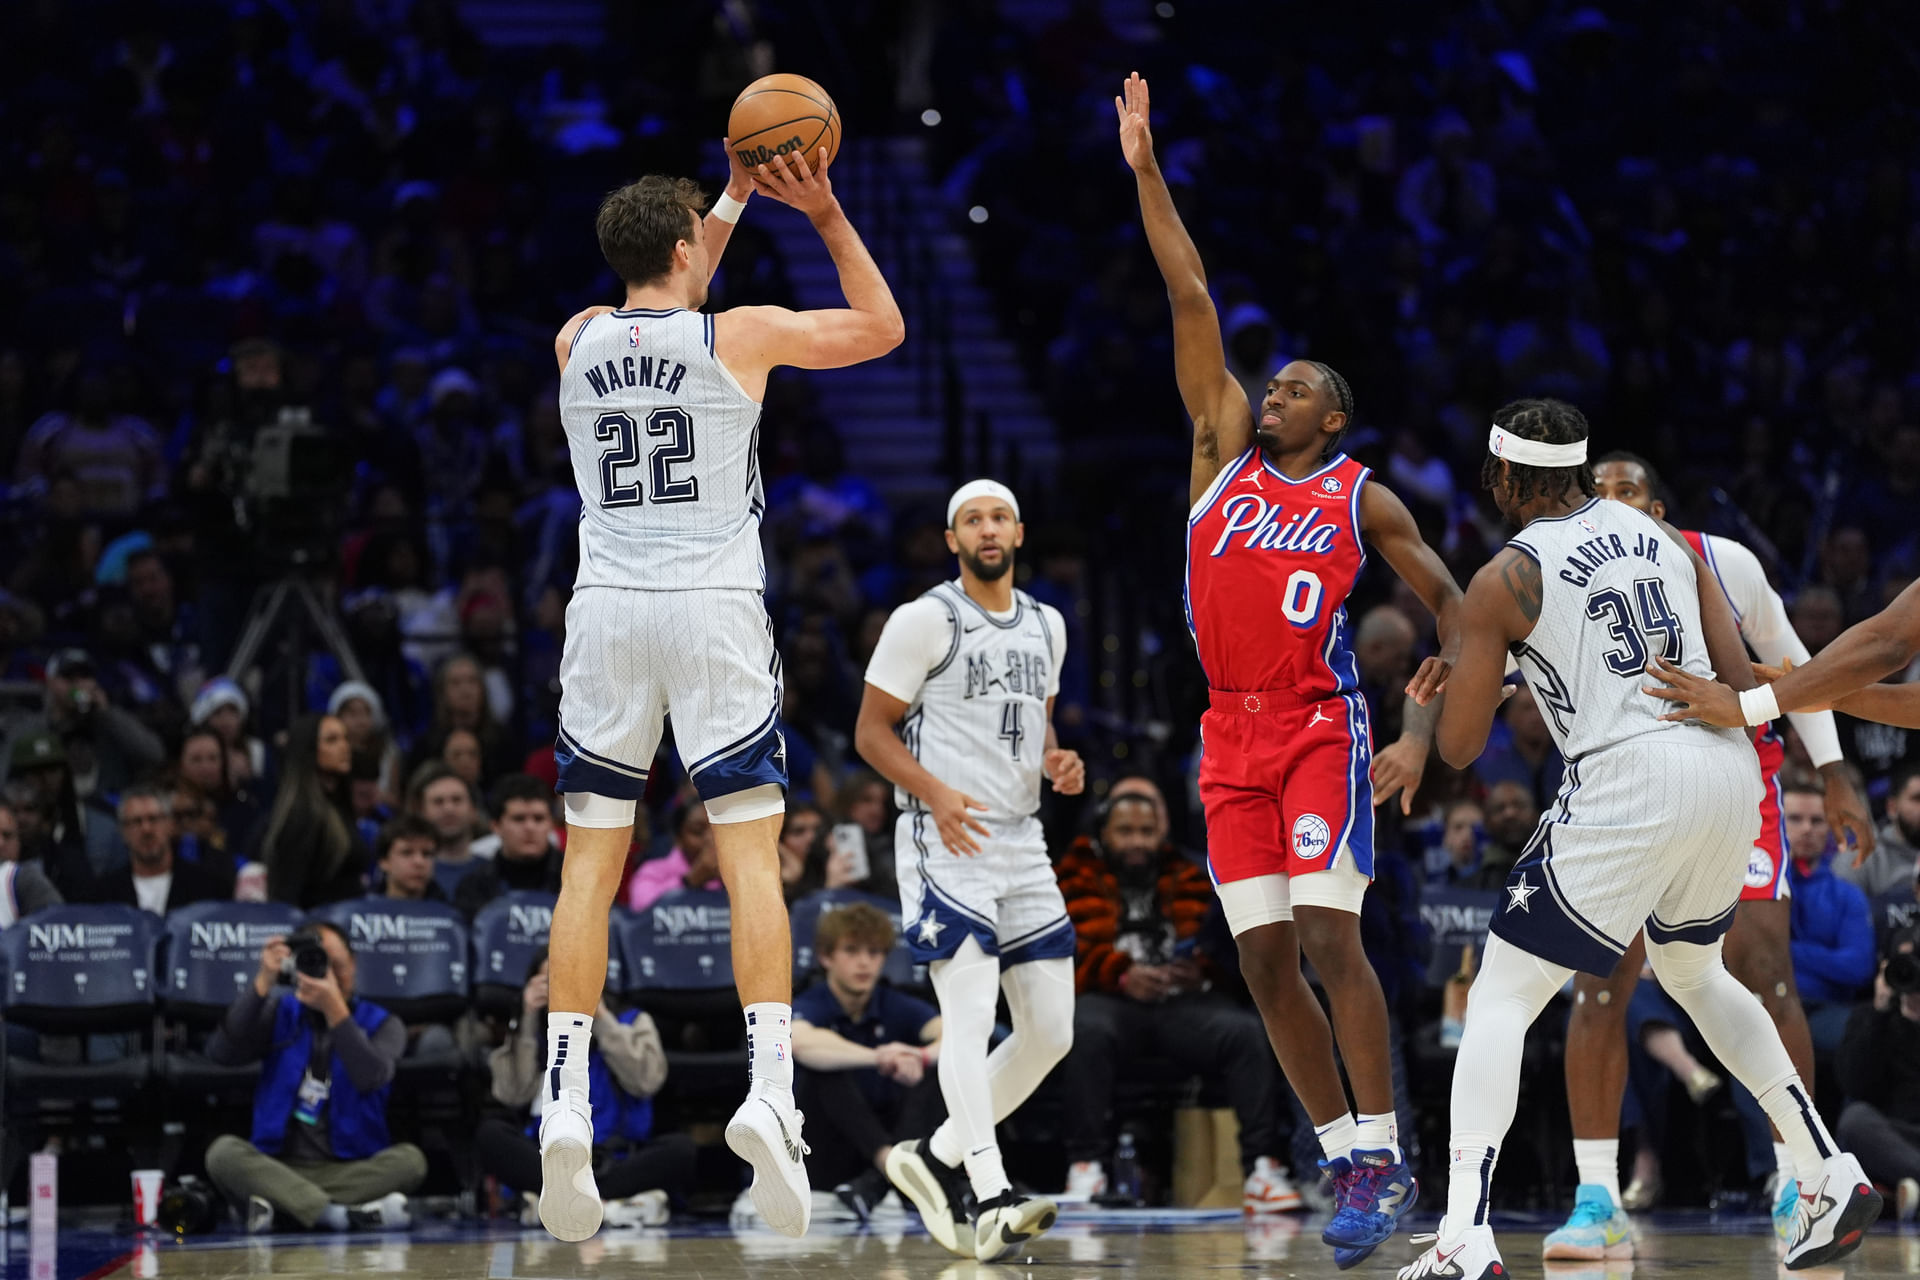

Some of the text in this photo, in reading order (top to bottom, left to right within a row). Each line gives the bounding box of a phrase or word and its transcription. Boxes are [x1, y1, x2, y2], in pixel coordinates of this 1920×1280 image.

[736, 135, 804, 168] Wilson
[585, 356, 687, 399] WAGNER
[594, 406, 699, 509] 22
[1311, 490, 1347, 500] crypto.com
[1210, 493, 1341, 558] Phila
[1559, 533, 1661, 588] CARTER JR.
[1281, 569, 1325, 629] 0
[1585, 576, 1684, 679] 34
[998, 699, 1024, 762] 4
[1295, 831, 1325, 848] 76ers
[29, 923, 86, 953] NJM
[191, 921, 246, 952] NJM
[351, 913, 406, 944] NJM
[653, 906, 708, 936] NJM
